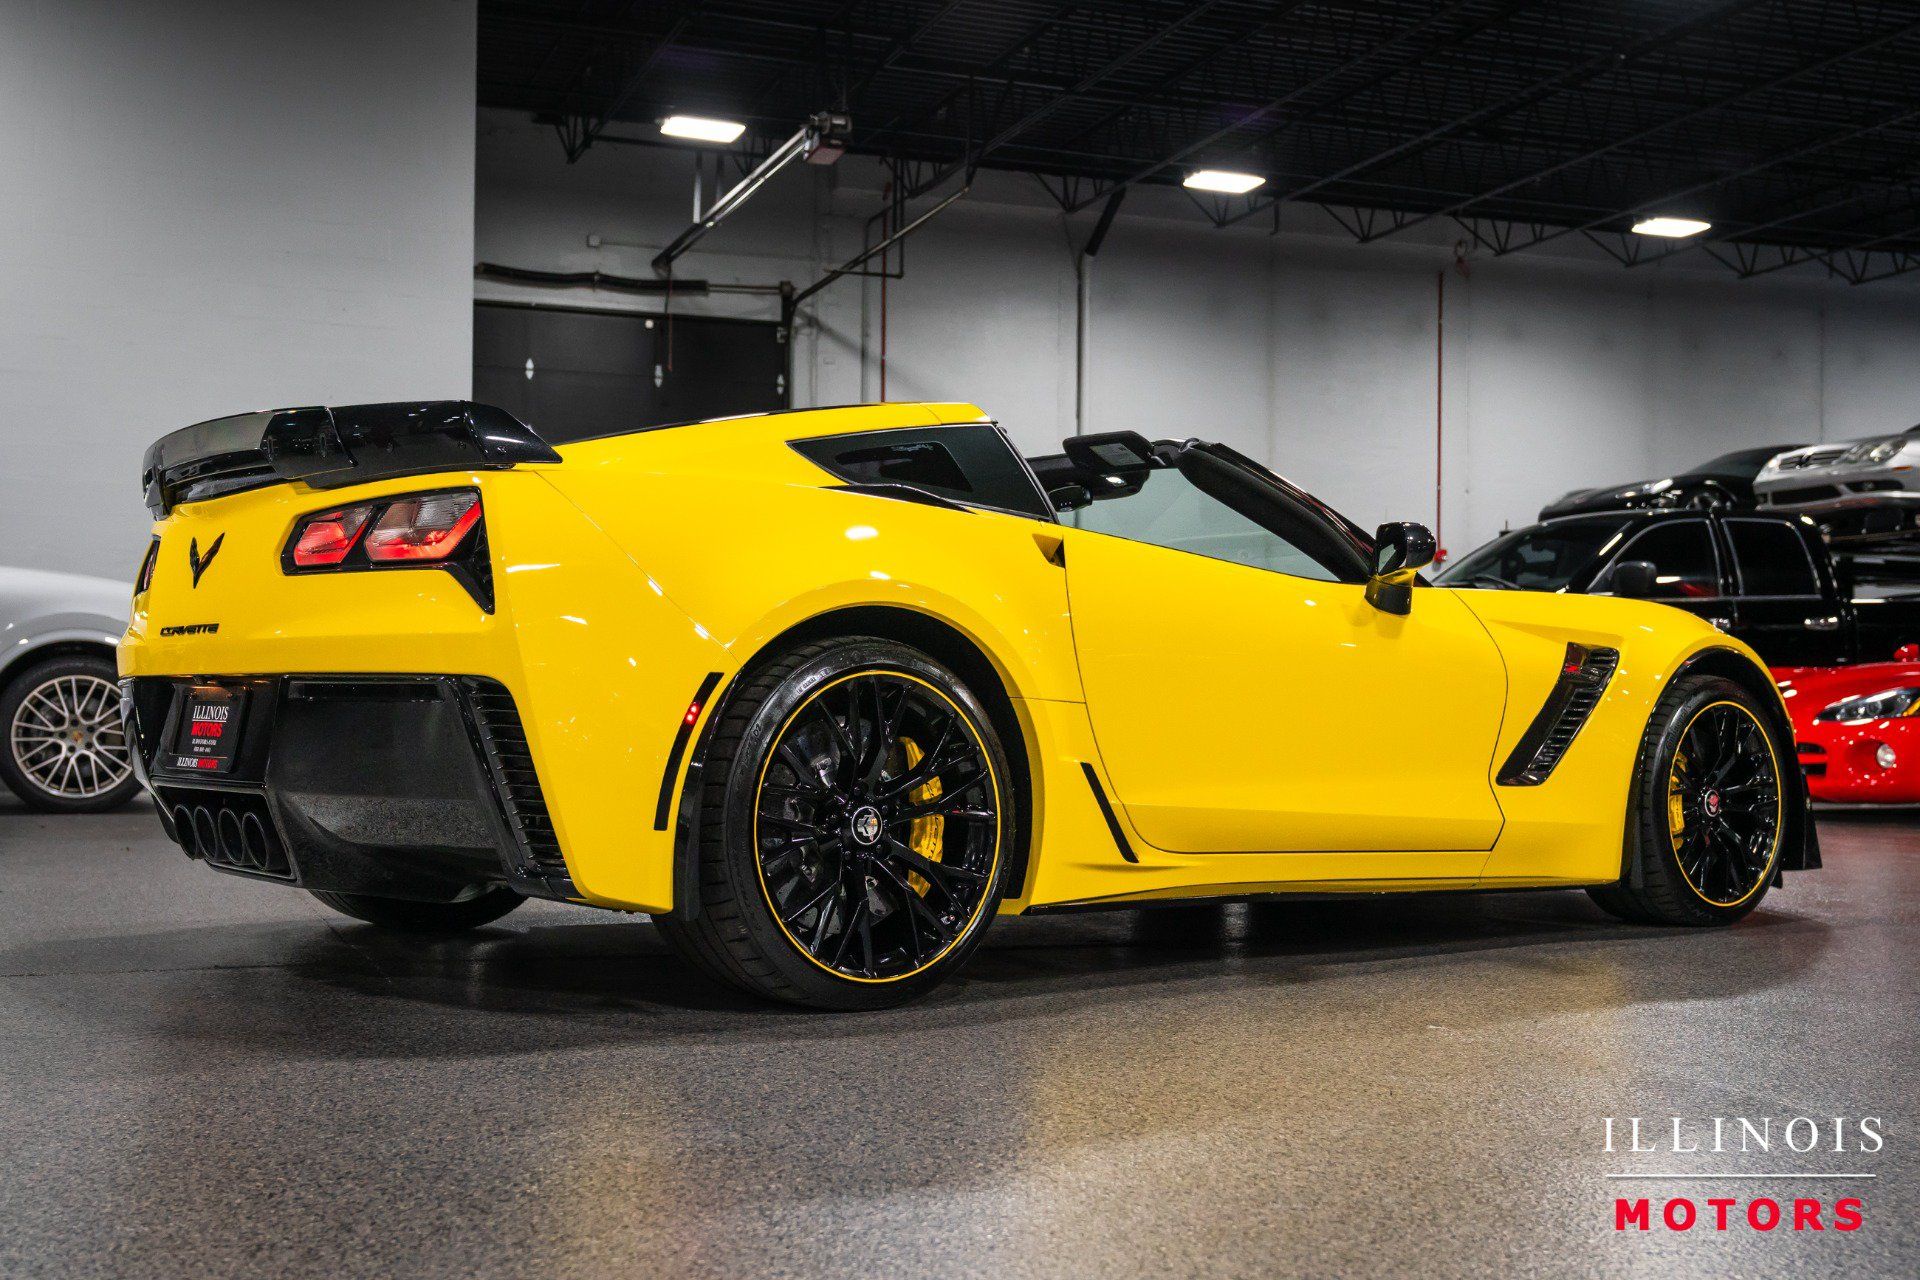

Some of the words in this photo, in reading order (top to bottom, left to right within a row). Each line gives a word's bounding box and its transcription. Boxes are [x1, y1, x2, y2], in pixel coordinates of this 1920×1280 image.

[160, 623, 220, 637] CORVETTE
[192, 705, 230, 720] ILLINOIS
[191, 721, 223, 737] MOTORS
[176, 757, 198, 768] ILLINOIS
